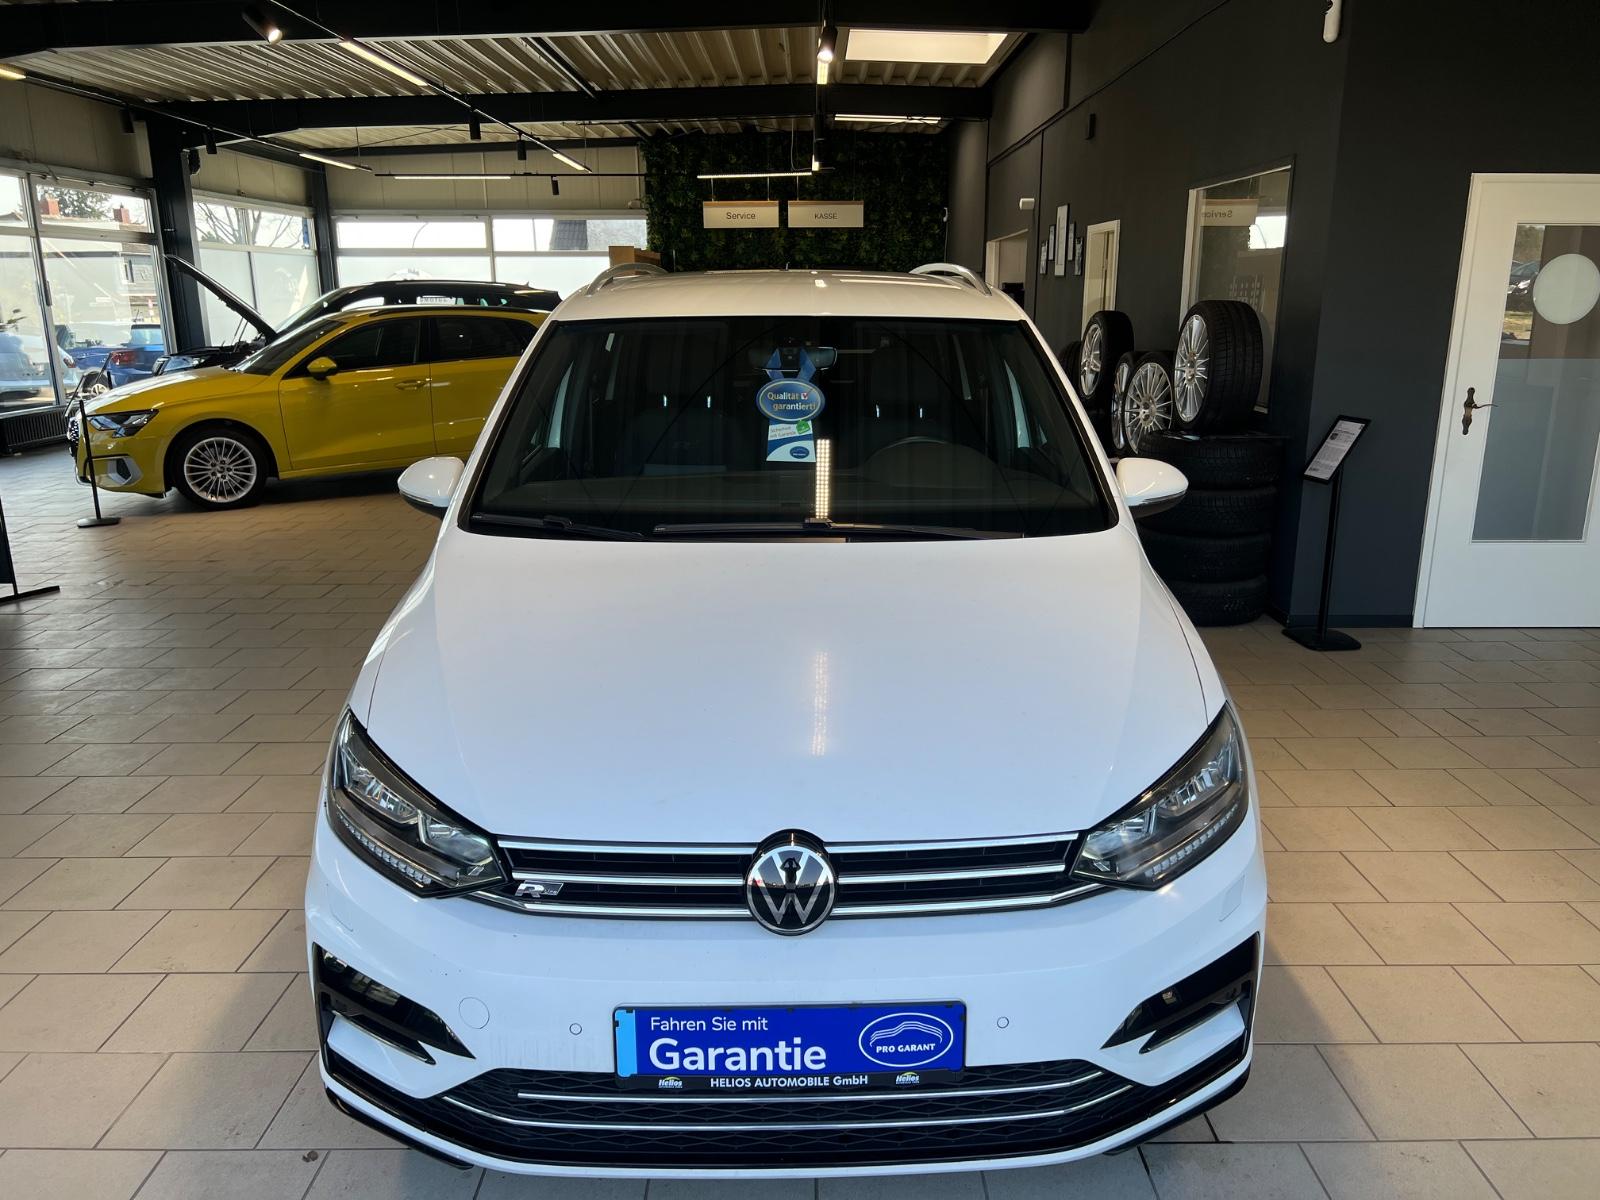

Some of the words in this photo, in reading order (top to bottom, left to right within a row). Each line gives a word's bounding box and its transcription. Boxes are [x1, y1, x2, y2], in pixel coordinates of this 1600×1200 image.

[726, 212, 756, 220] Service
[767, 392, 799, 401] Qualität
[651, 1016, 706, 1031] Fahren
[711, 1016, 737, 1031] Sie
[742, 1016, 768, 1031] mit
[876, 1045, 895, 1053] PRO
[897, 1043, 936, 1052] GARANT
[649, 1037, 827, 1071] Garantie
[658, 1079, 683, 1087] Helios
[710, 1078, 751, 1088] HELIOS
[754, 1076, 830, 1088] AUTOMOBILE
[833, 1075, 868, 1086] GmbH
